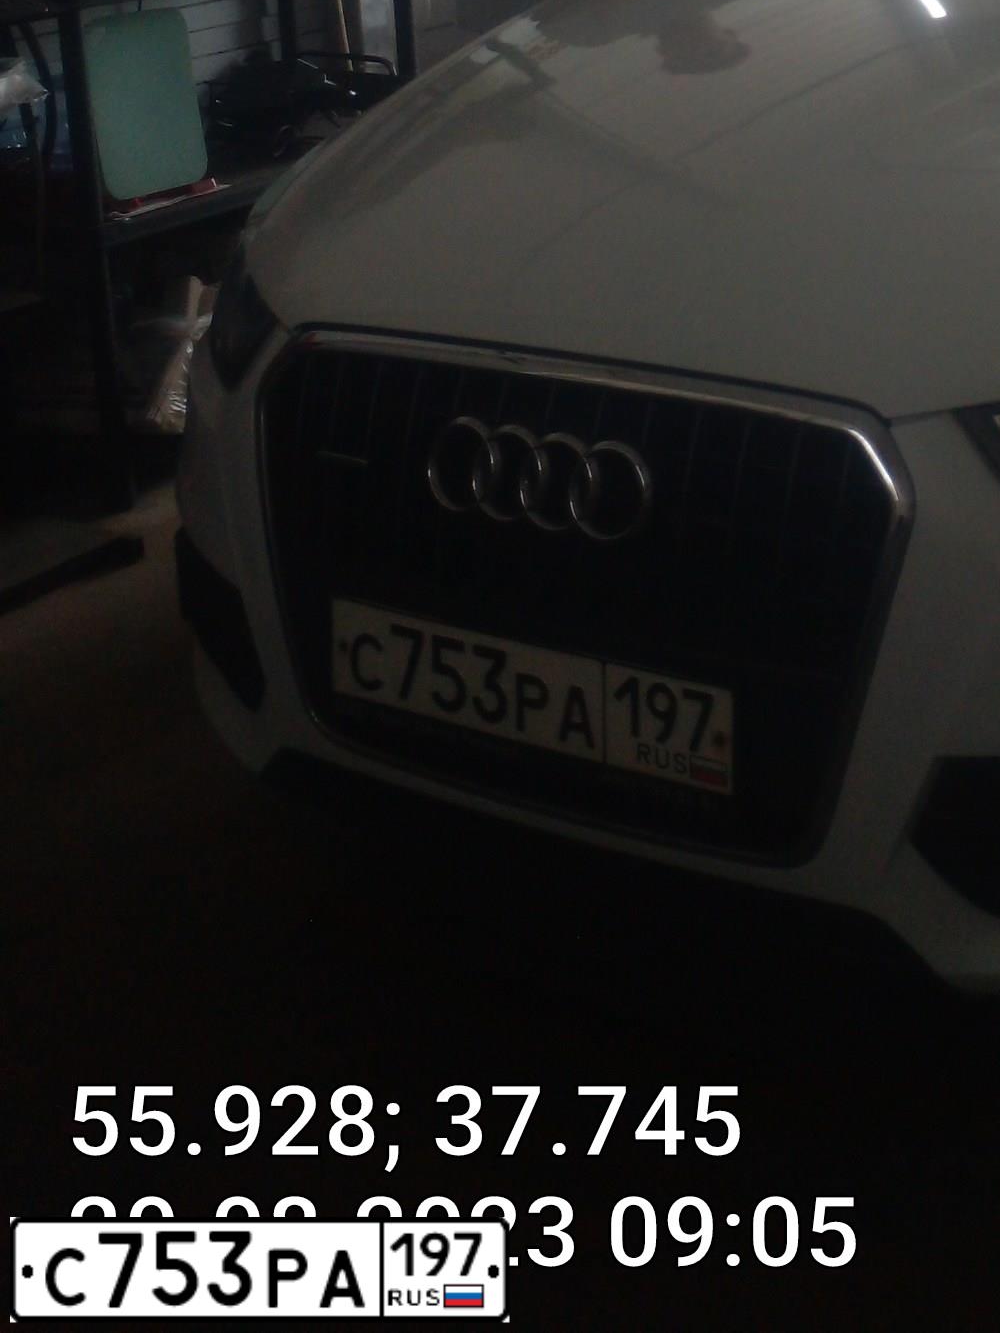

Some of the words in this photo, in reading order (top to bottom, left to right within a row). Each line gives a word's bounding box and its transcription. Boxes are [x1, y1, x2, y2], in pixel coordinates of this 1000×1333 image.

[350, 623, 596, 749] С753РА
[614, 677, 713, 752] 197
[637, 744, 689, 774] RUS
